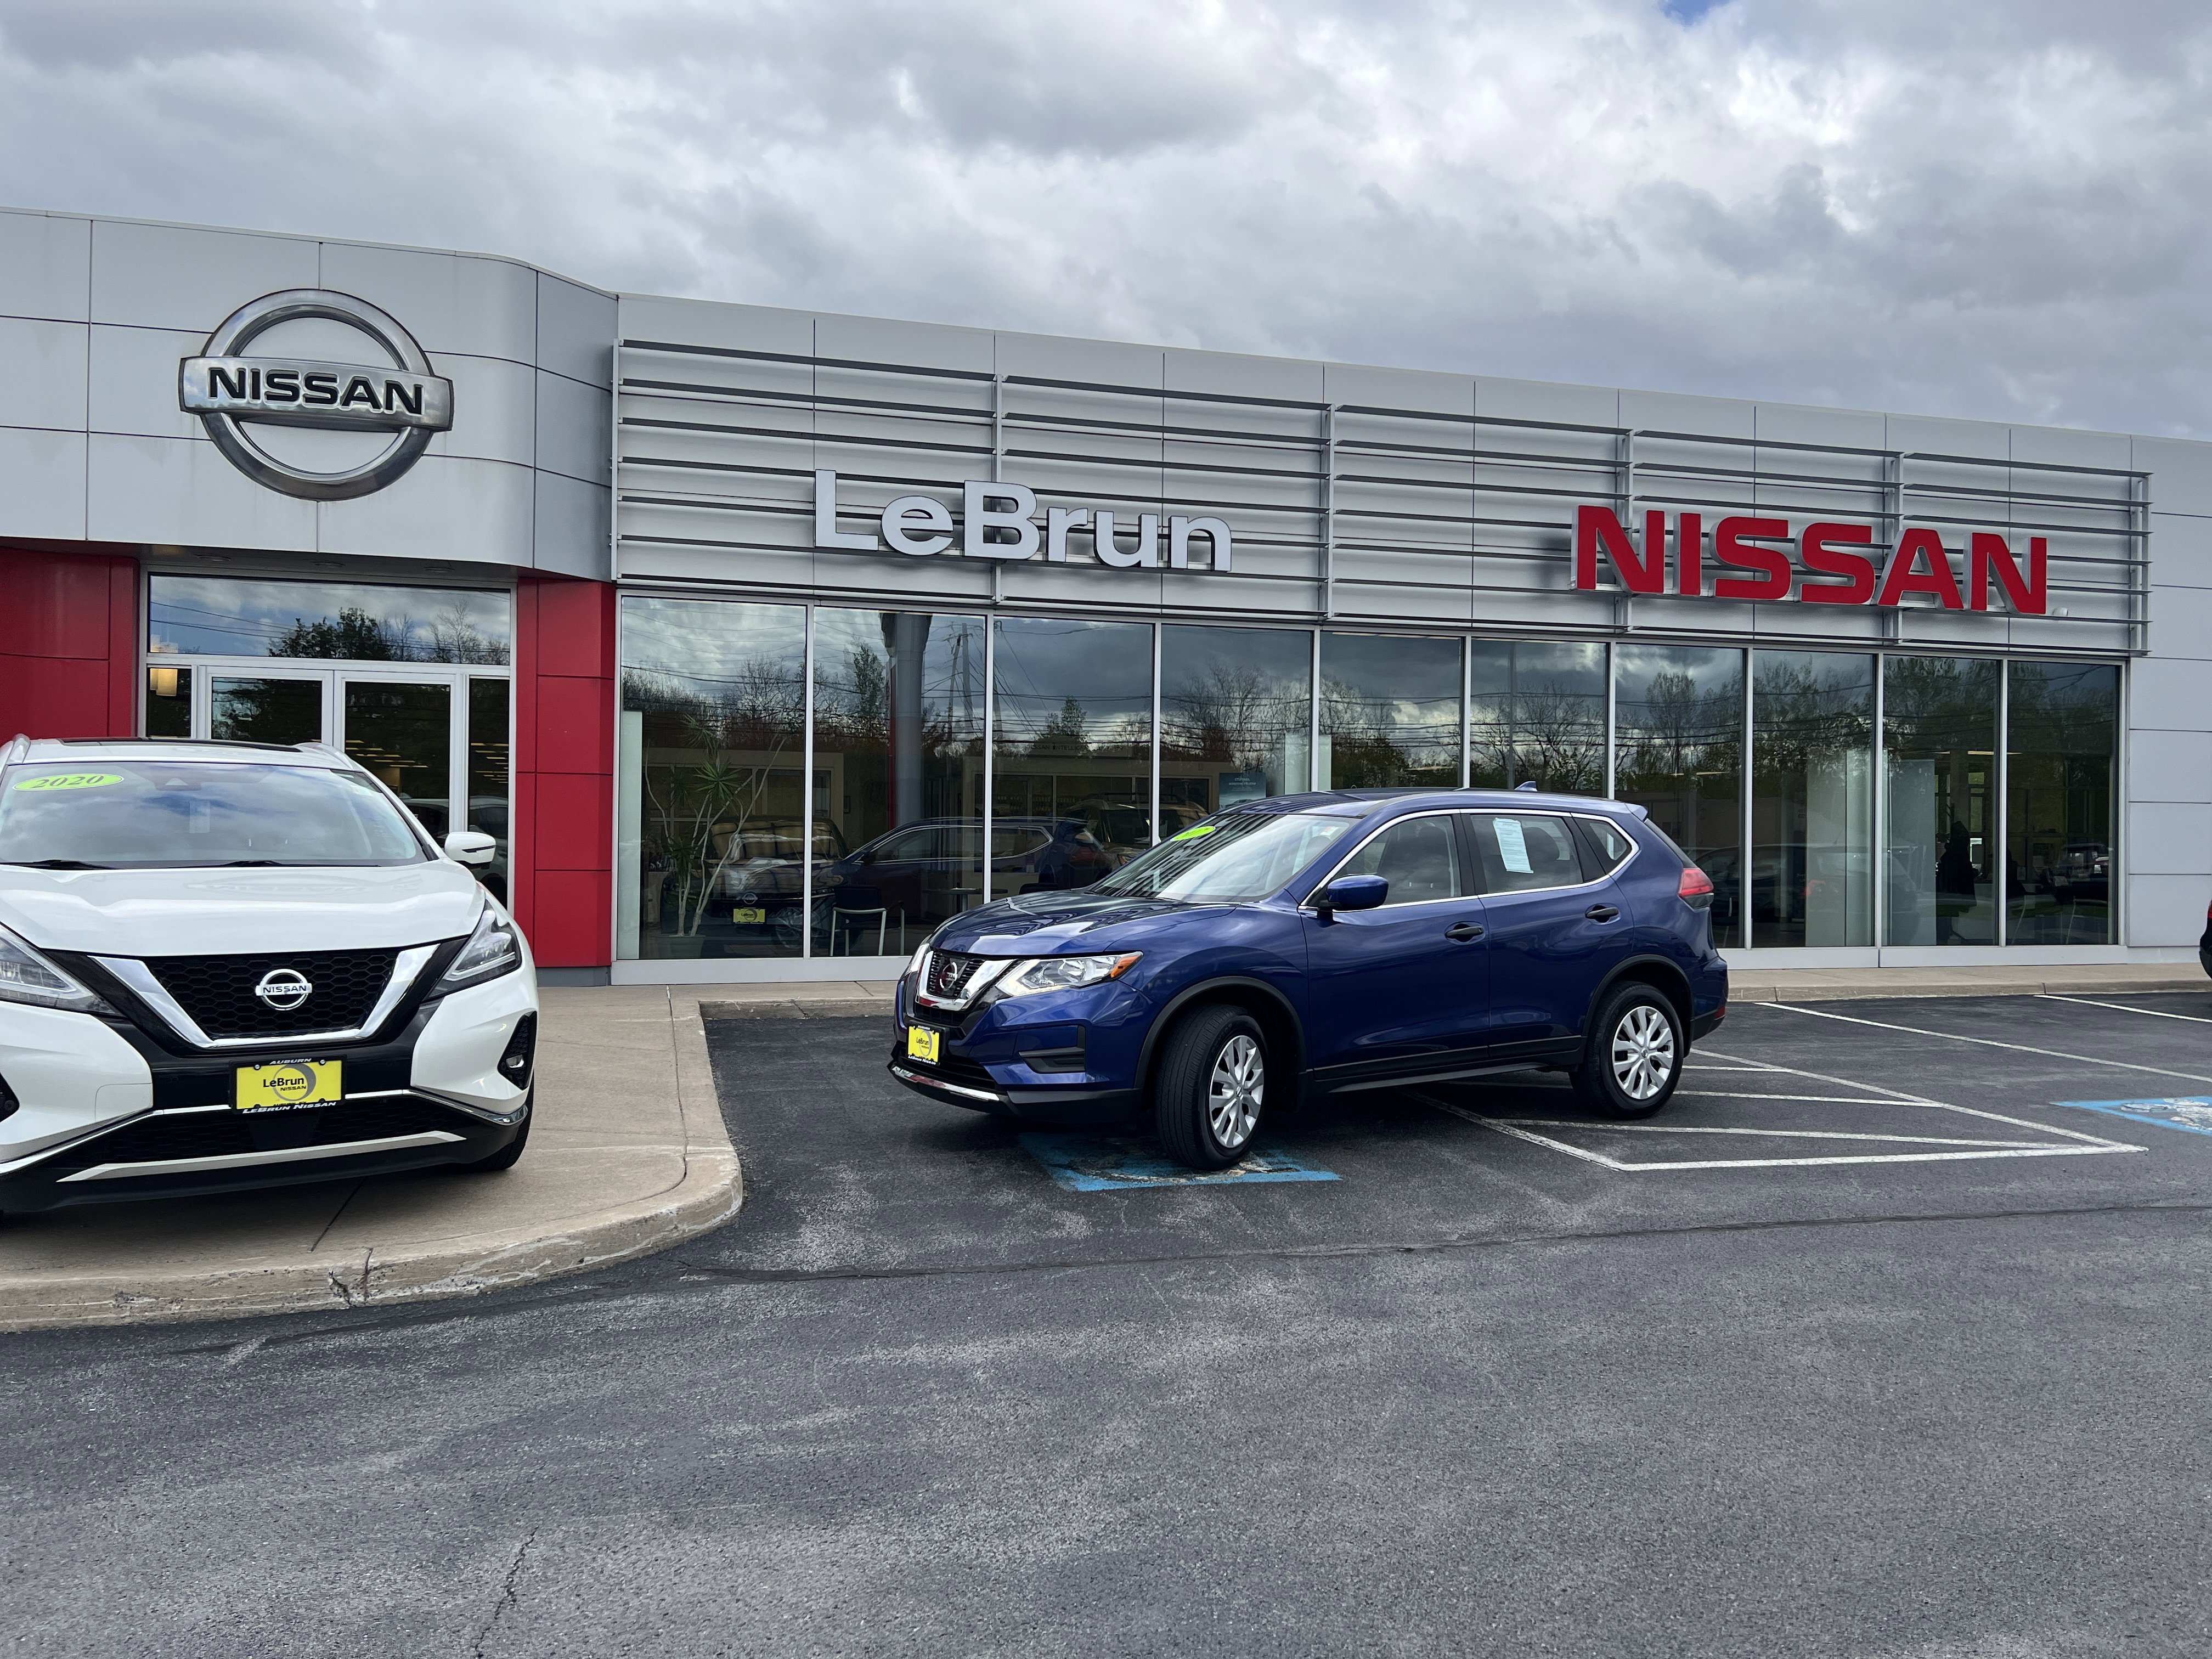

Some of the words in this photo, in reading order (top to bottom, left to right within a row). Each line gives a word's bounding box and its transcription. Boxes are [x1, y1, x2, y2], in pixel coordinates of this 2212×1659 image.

[208, 368, 424, 415] NISSAN
[815, 469, 1232, 572] LeBrun
[1572, 505, 2047, 615] NISSAN
[32, 775, 104, 788] 2020
[263, 985, 306, 994] NISSAN
[263, 1077, 304, 1087] LeBrun
